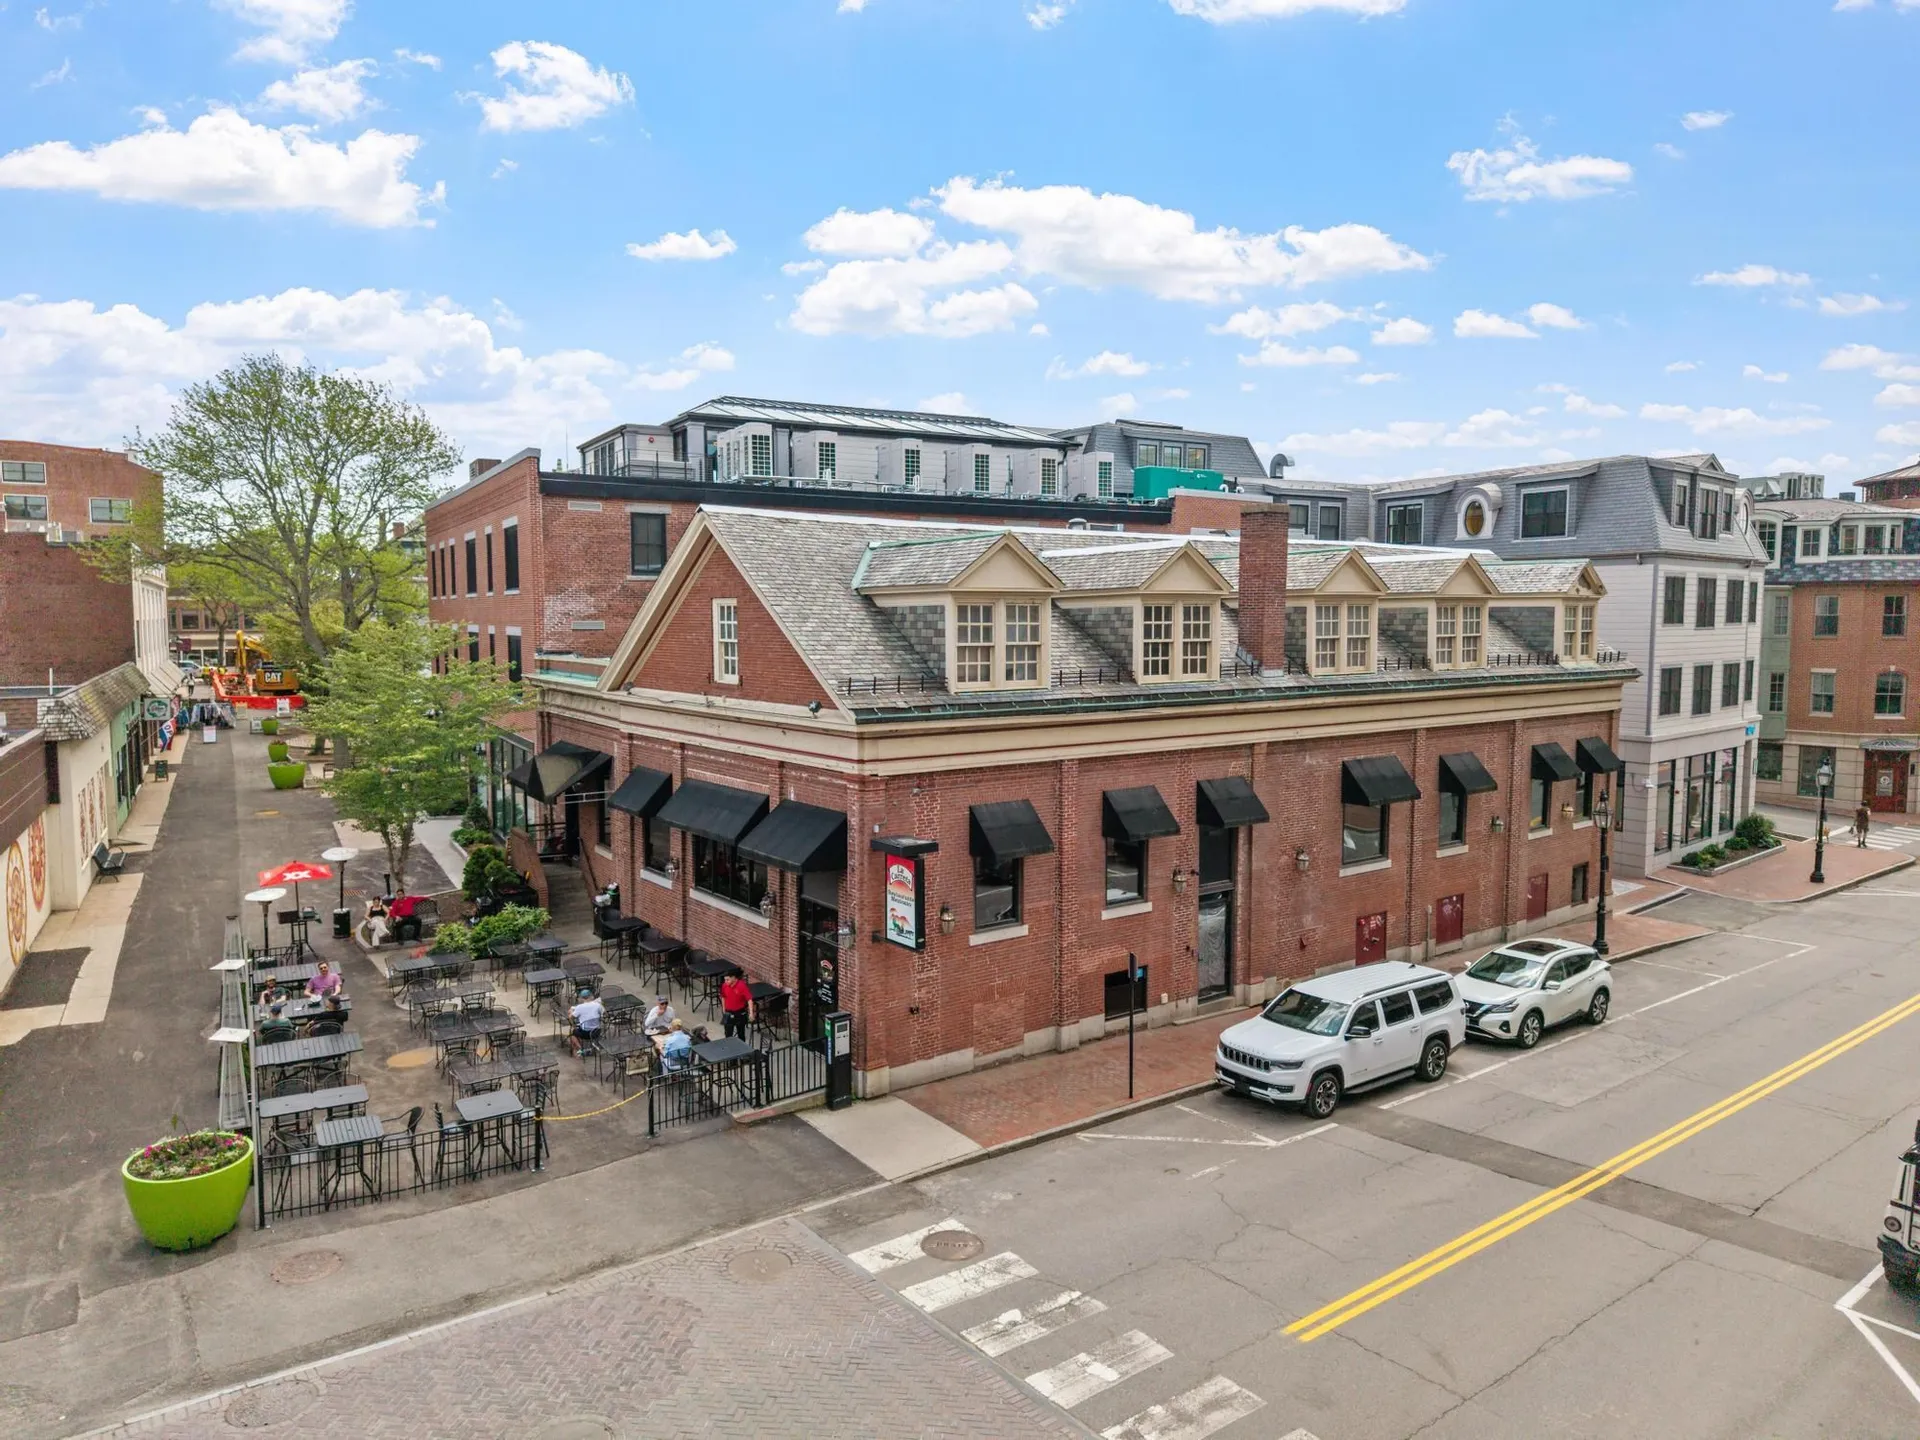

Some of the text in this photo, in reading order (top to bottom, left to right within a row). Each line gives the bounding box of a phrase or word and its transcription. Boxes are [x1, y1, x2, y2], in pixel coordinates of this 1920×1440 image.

[265, 672, 282, 683] CAT
[896, 865, 905, 874] La
[283, 870, 312, 880] XX
[891, 871, 911, 885] Carreta
